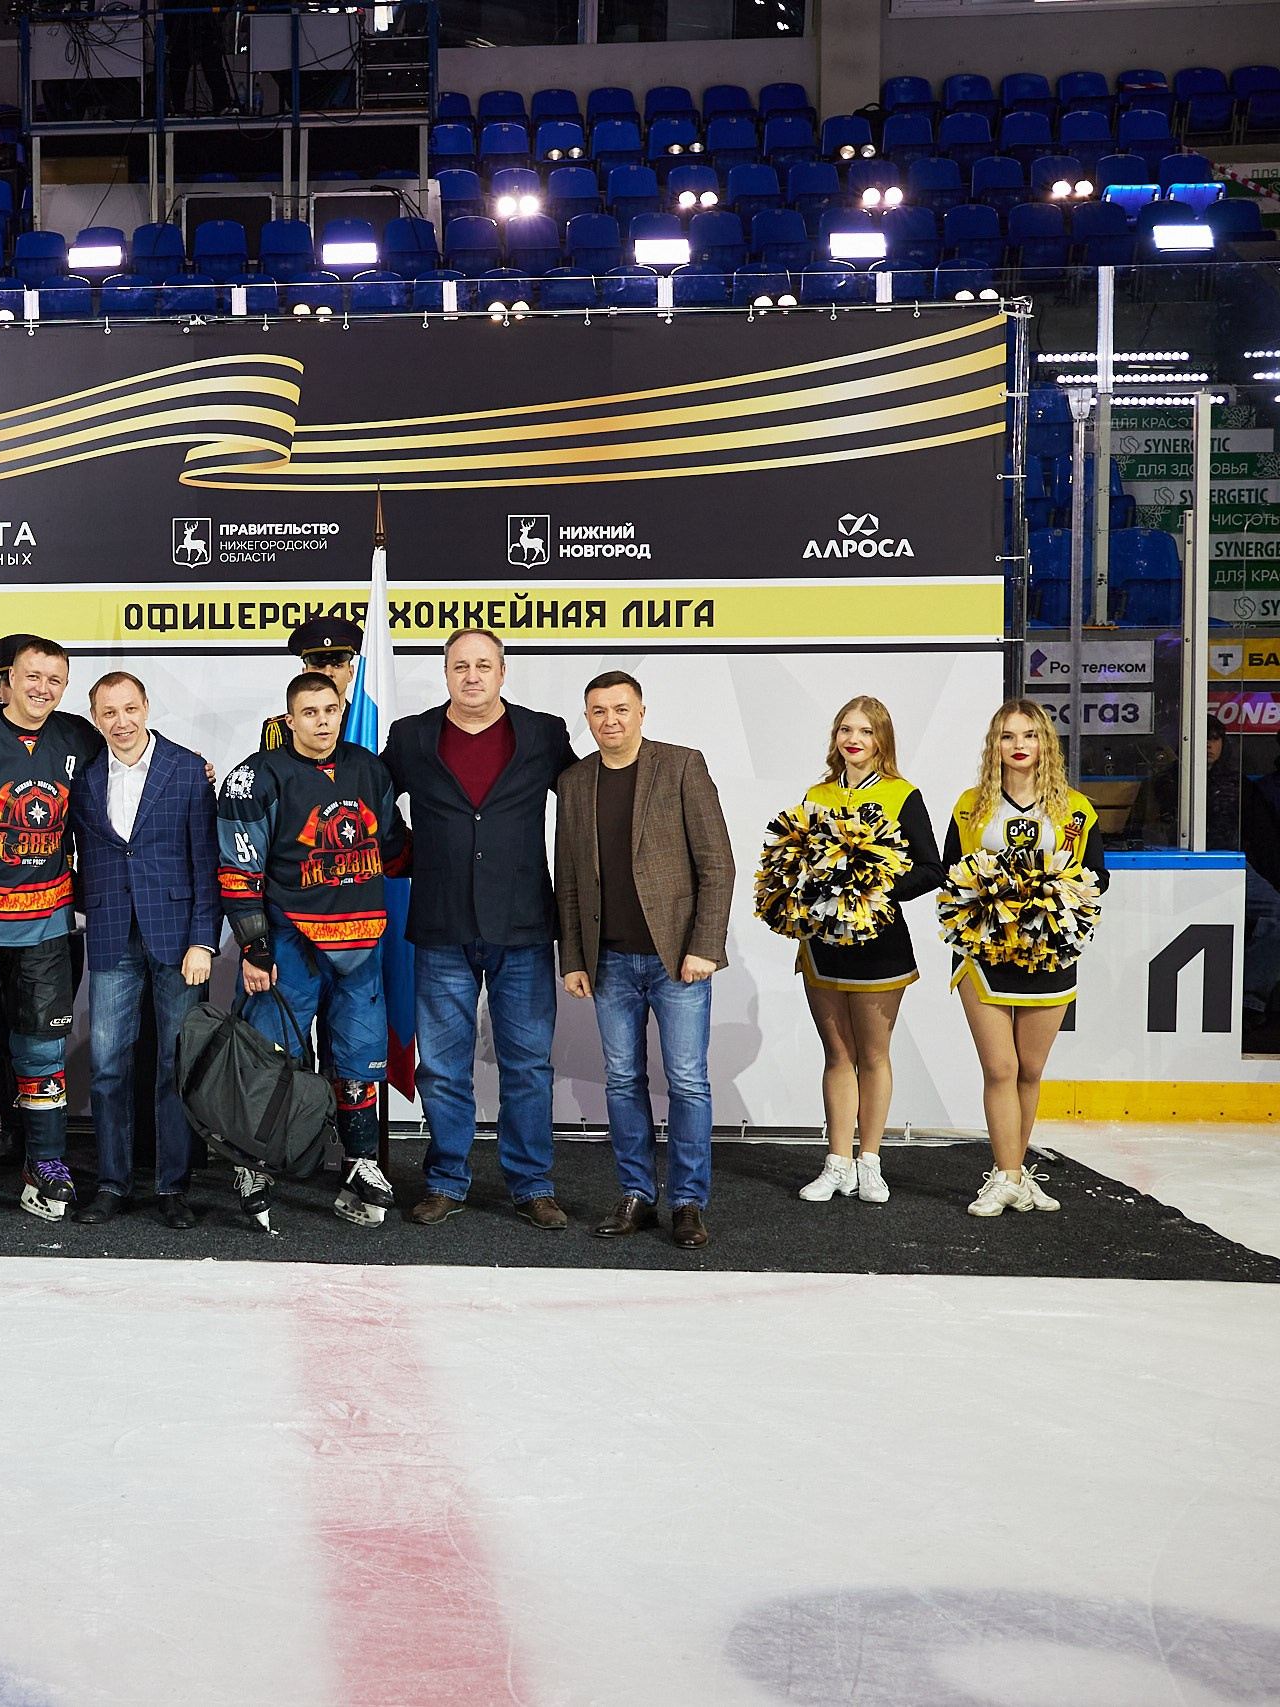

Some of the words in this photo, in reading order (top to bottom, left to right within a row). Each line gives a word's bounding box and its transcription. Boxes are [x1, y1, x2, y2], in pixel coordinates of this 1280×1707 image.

[1110, 417, 1138, 429] ДЛЯ
[1144, 437, 1231, 453] SYNERTIC
[1136, 464, 1167, 478] ДЛЯ
[1179, 488, 1269, 504] SYERGETIC
[219, 523, 340, 536] ПРАВИТЕЛЬСТВО
[559, 521, 635, 540] НИЖНИЙ
[219, 537, 328, 551] НИЖЕГОРОДСКОЙ
[559, 543, 652, 560] НОВГОРОД
[802, 538, 915, 559] АЛРОСА
[219, 552, 276, 563] ОБЛАСТИ
[1214, 570, 1247, 584] ДЛЯ
[388, 591, 606, 629] ХОККЕЙНАЯ
[621, 598, 714, 628] ЛИГА
[1050, 661, 1146, 674] Ротелеком
[300, 859, 325, 888] ХК
